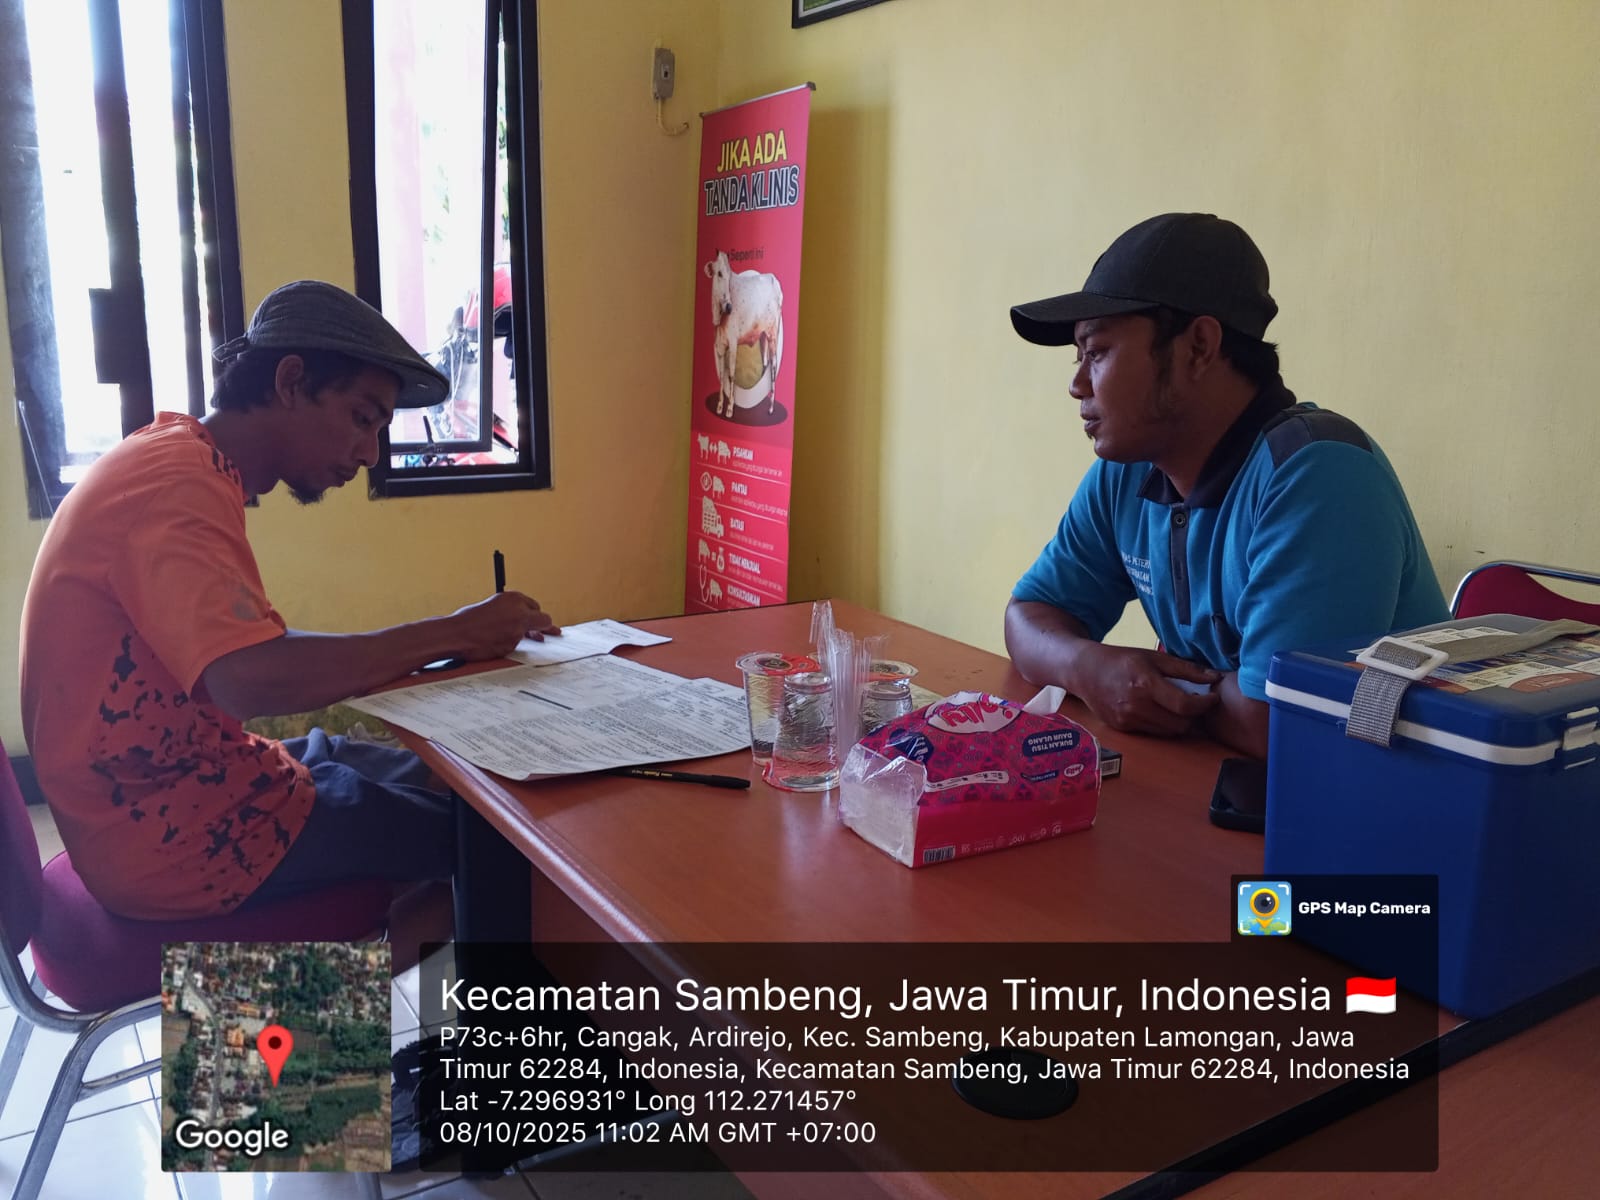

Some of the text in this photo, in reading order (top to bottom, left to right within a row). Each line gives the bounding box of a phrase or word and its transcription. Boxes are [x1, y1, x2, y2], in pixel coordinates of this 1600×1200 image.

[717, 129, 787, 173] JIKA ADA
[704, 165, 800, 216] TANDA KLINIS
[1028, 732, 1073, 745] DAUR ULANG
[1031, 739, 1073, 753] BUKAN TISU
